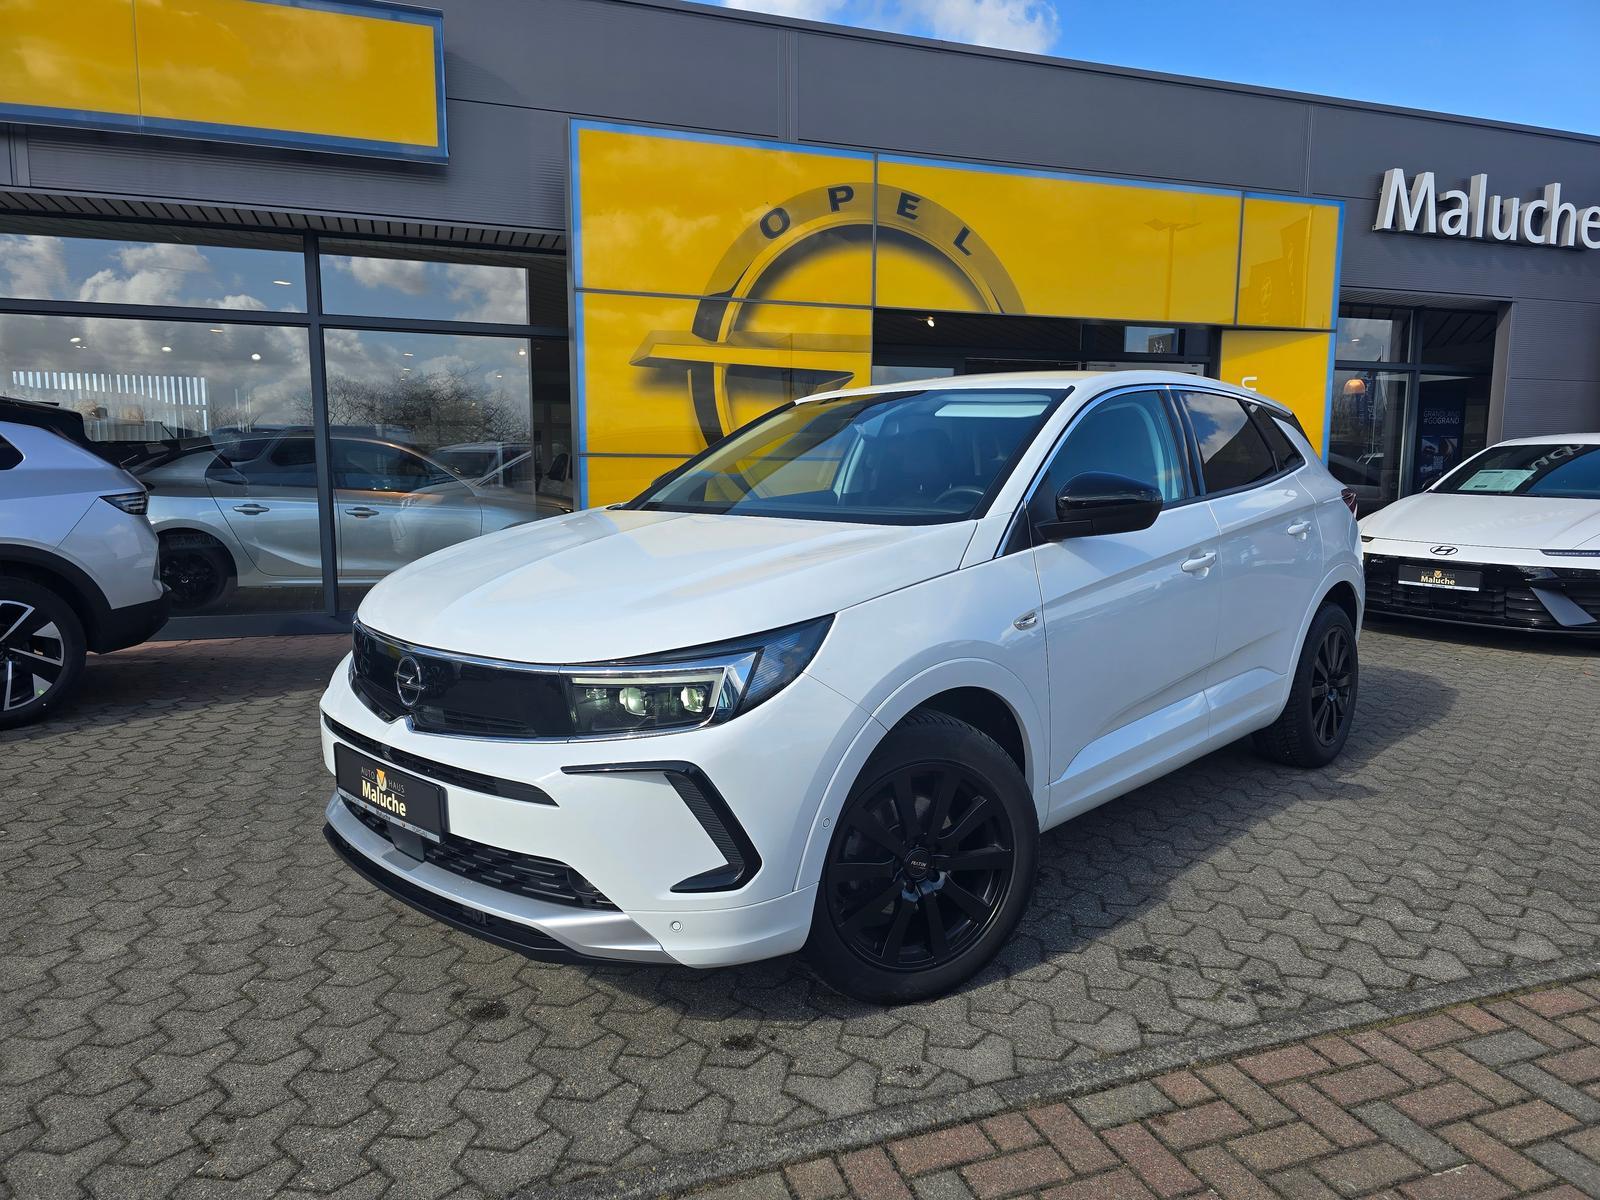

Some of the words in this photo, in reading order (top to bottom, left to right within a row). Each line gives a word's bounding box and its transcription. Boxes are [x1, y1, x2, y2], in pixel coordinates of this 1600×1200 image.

[759, 184, 974, 256] OPEL
[1376, 168, 1600, 250] Maluche
[1420, 575, 1456, 586] Maluche
[361, 767, 375, 779] AUTO
[388, 781, 405, 794] HAUS
[361, 779, 407, 817] Maluche
